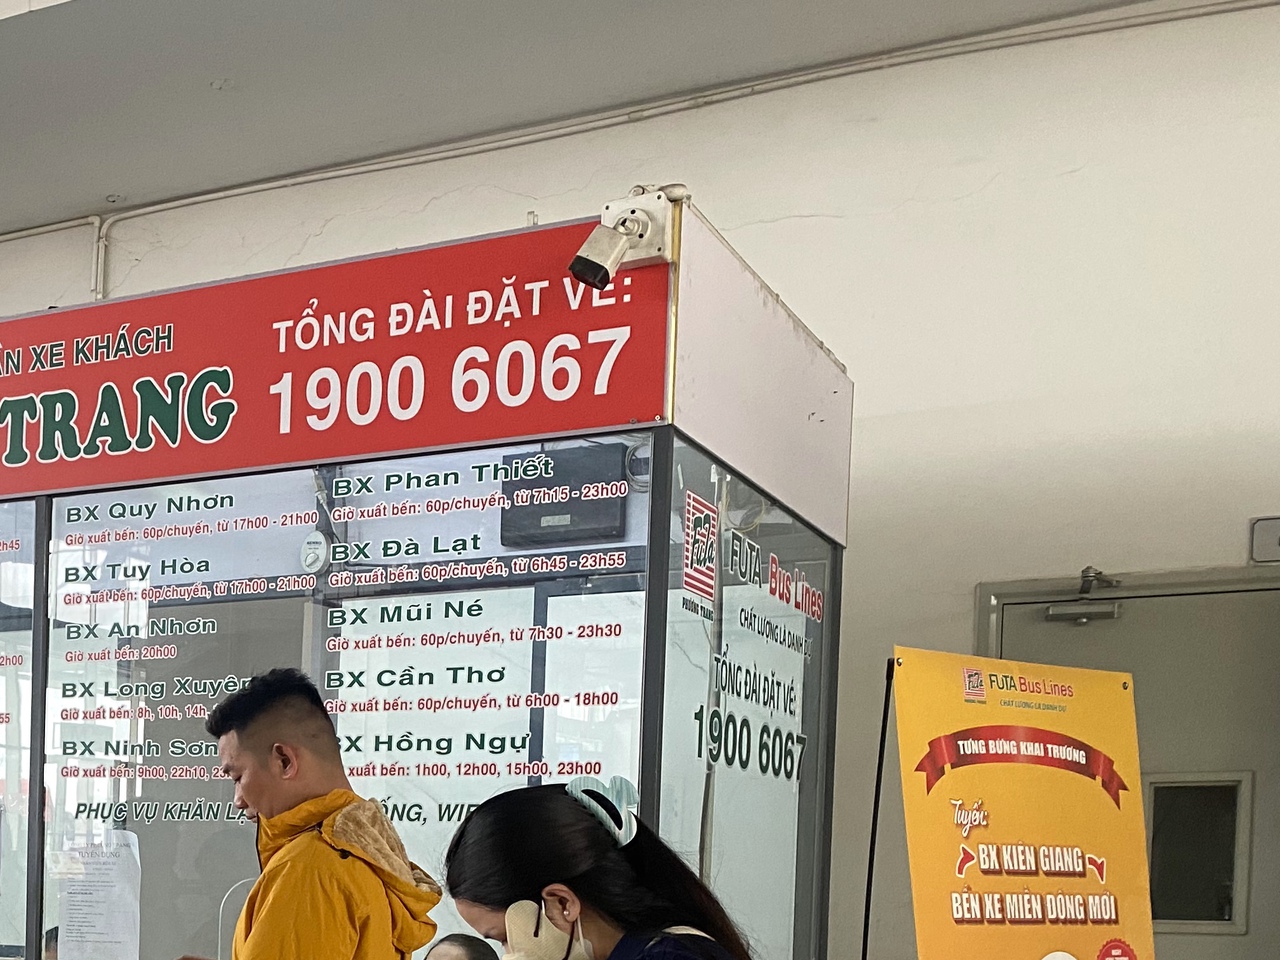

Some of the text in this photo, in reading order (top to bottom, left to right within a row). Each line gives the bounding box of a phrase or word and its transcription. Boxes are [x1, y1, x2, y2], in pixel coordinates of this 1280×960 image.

[272, 298, 375, 353] TỔNG
[389, 289, 452, 336] ĐÀI
[467, 275, 549, 327] ĐẶT
[29, 343, 67, 371] XE
[73, 322, 174, 365] KHÁCH
[269, 325, 631, 434] 1900 6067
[333, 455, 554, 497] BX Phan Thiết
[66, 495, 234, 523] BX Quy Nhơn
[332, 507, 353, 522] Giờ
[358, 504, 387, 519] xuất
[392, 502, 421, 517] bến:
[426, 494, 510, 514] 60p/chuyến,
[515, 490, 531, 504] từ
[534, 486, 569, 503] 7h15
[582, 481, 628, 498] 23h00
[331, 542, 371, 562] BX
[382, 537, 420, 557] Đà
[433, 533, 481, 554] Lạt
[64, 558, 210, 582] BX Tuy Hòa
[730, 530, 823, 623] FUTA Bus Lines
[66, 618, 217, 640] BX An Nhơn
[65, 646, 177, 662] Giờ xuất bến: 20h00
[326, 666, 505, 688] BX Cần Thơ
[714, 644, 797, 717] TỔNG ĐÀI ĐẶT VÉ:
[989, 674, 1074, 697] FUTA Bus Lines
[694, 705, 808, 781] 1900 6067
[1020, 742, 1044, 756] KHAI
[1046, 744, 1086, 764] TRƯƠNG
[978, 840, 1084, 872] BX KIÊN GIANG
[951, 885, 1116, 920] BẾN XE MIỀN ĐÔNG MỚI
